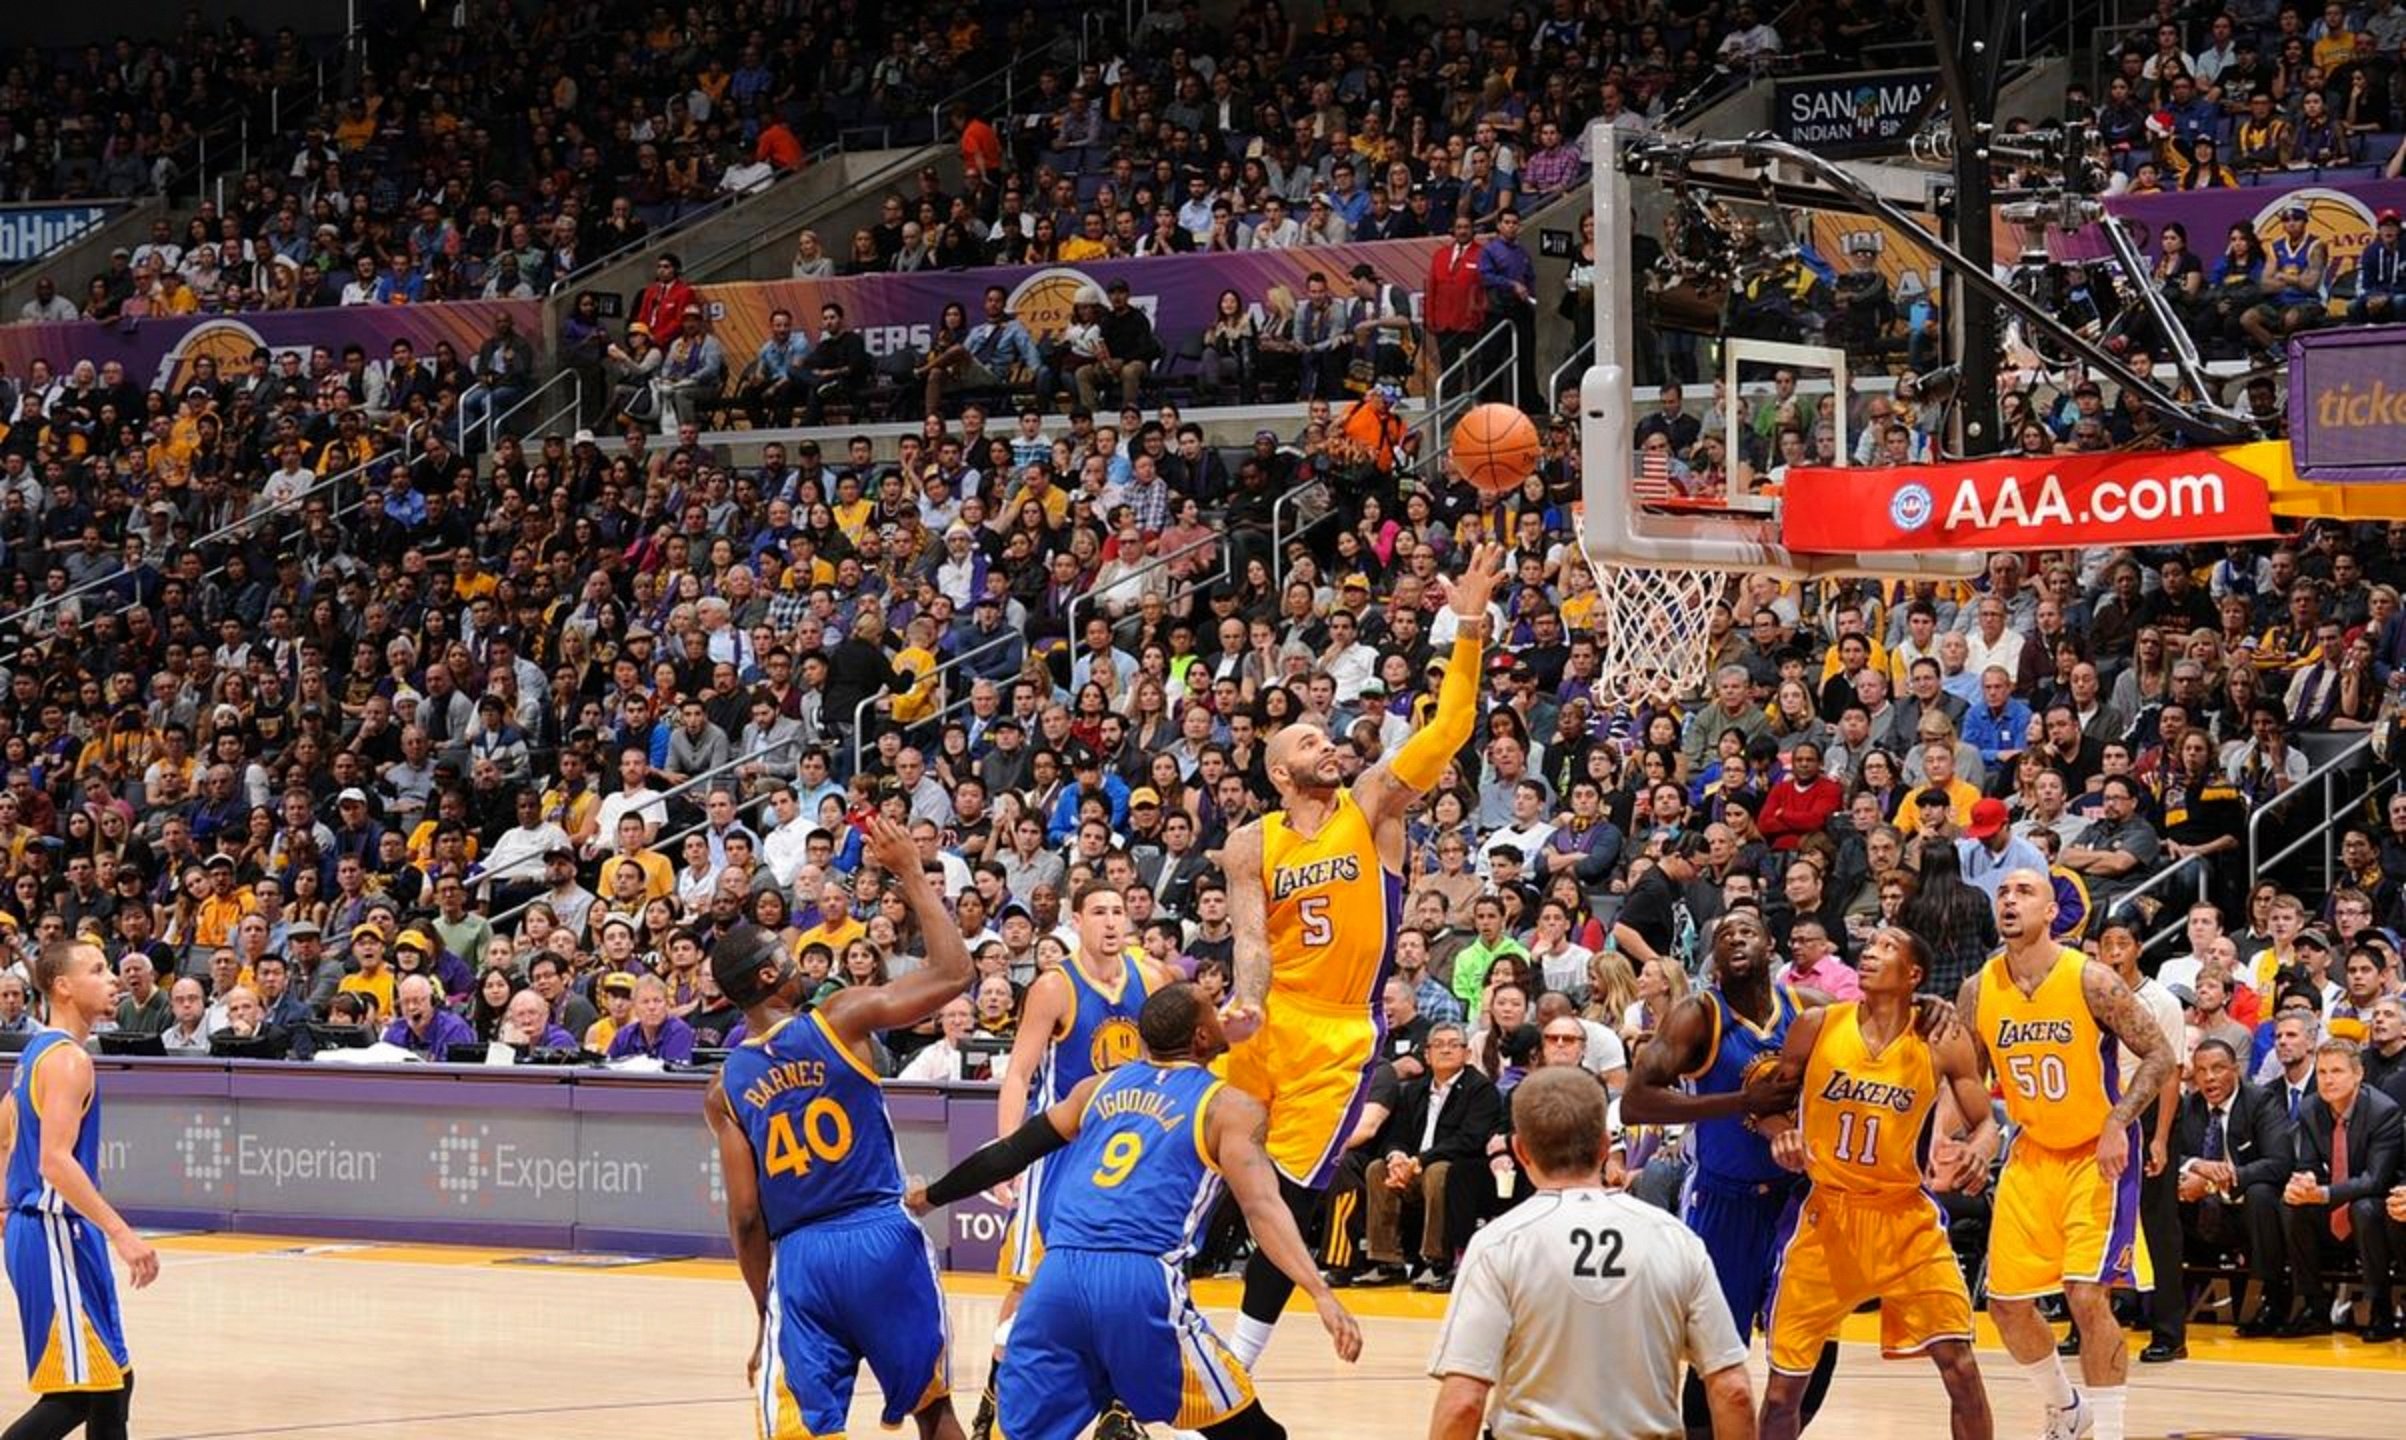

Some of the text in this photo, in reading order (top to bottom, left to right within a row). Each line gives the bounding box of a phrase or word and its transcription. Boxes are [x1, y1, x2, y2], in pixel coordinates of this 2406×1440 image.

[1791, 89, 1852, 124] SAN
[1792, 122, 1853, 143] INDIAN
[1945, 472, 2226, 530] AAA.com
[1272, 855, 1360, 902] LAKERS
[1298, 895, 1334, 947] 5
[1996, 1019, 2073, 1049] LAKERS
[743, 1060, 825, 1111] BARNES
[1822, 1069, 1917, 1113] LAKERS
[2007, 1054, 2068, 1102] 50
[238, 1134, 377, 1187] Experian
[765, 1096, 854, 1178] 40
[1091, 1130, 1142, 1188] 9
[1834, 1111, 1881, 1165] 11
[496, 1144, 643, 1198] Experian
[955, 1212, 1009, 1241] TOY
[1569, 1226, 1627, 1279] 22
